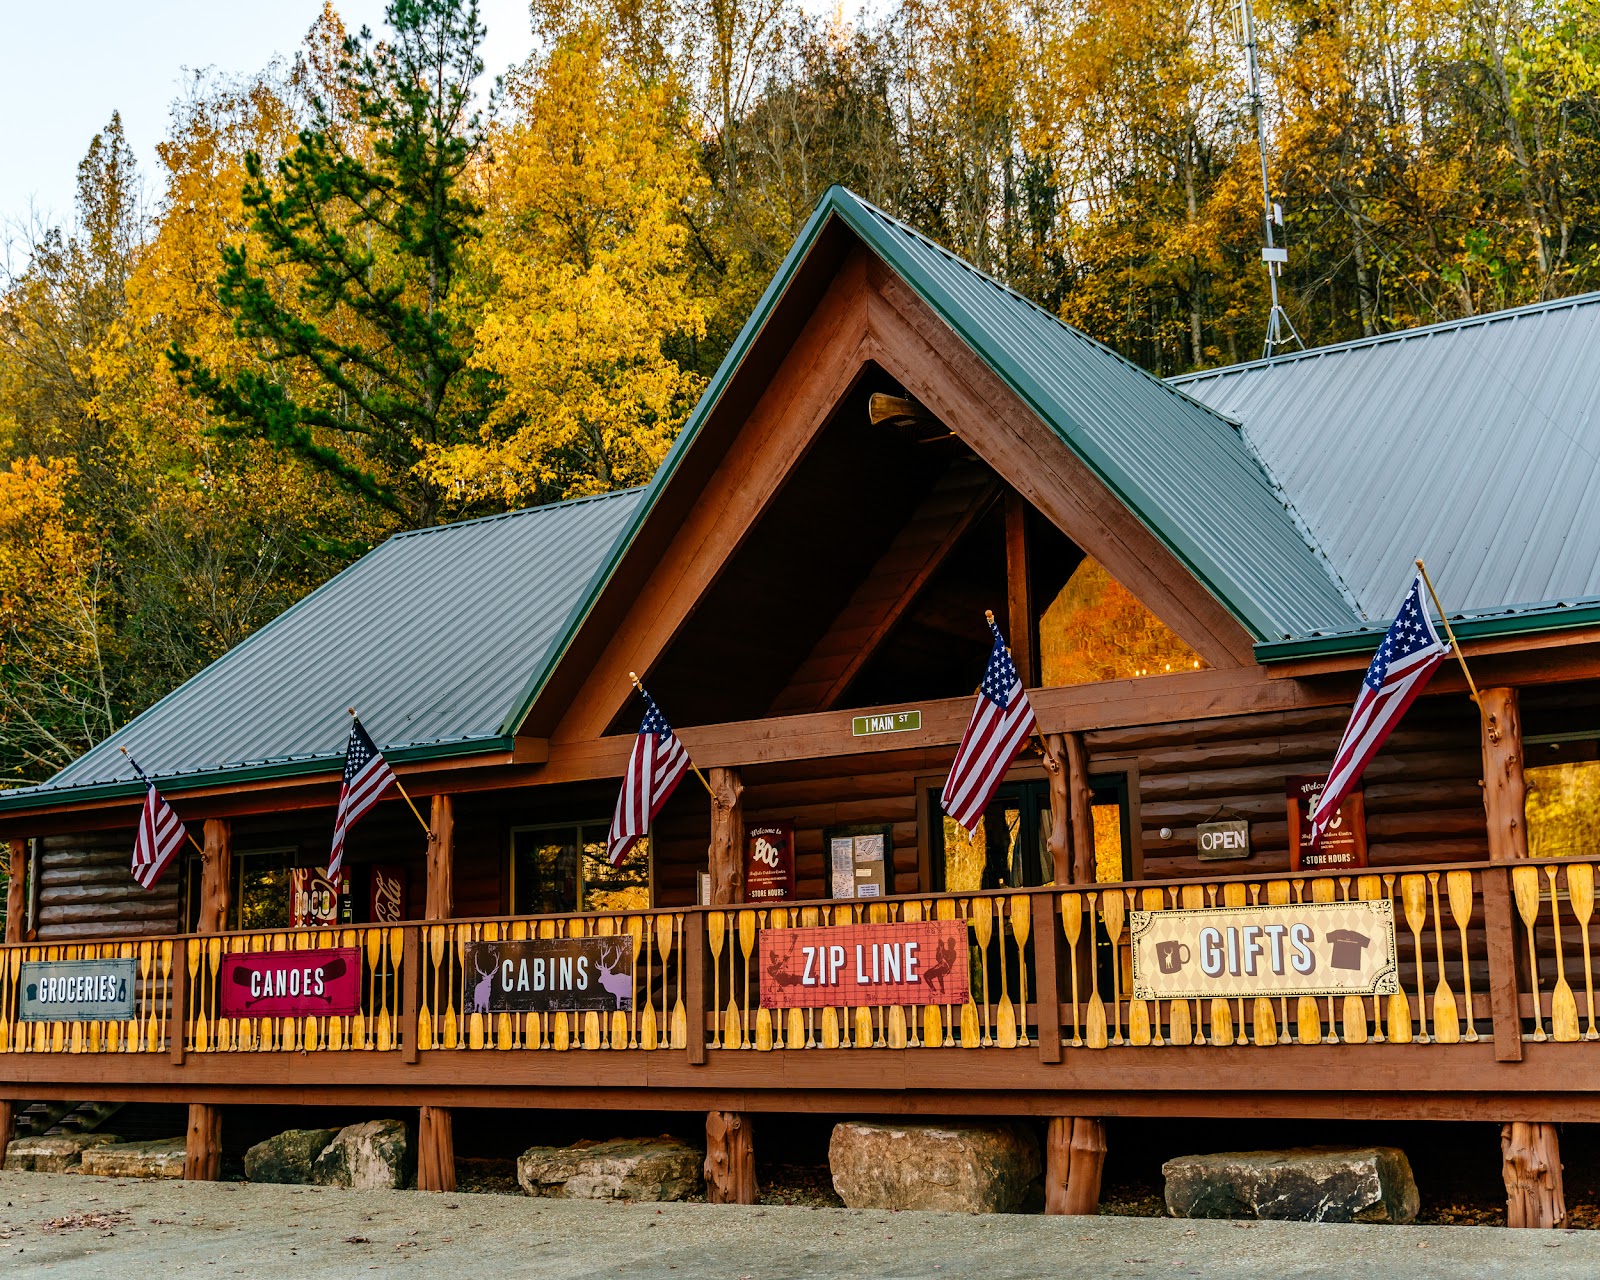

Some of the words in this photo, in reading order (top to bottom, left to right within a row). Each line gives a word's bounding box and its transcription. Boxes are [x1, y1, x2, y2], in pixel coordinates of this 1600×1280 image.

[871, 716, 894, 731] MAIN
[899, 714, 908, 722] ST
[1301, 782, 1326, 793] Welco
[753, 837, 779, 868] BOC
[1201, 830, 1246, 850] OPEN
[1306, 855, 1327, 864] STORE
[1328, 853, 1351, 863] HOURS
[751, 889, 767, 898] STORE
[767, 888, 785, 897] HOURS
[802, 945, 846, 987] ZIP
[856, 942, 920, 984] LINE
[1199, 923, 1316, 978] GIFTS
[251, 967, 324, 998] CANOES
[501, 956, 588, 992] CABINS
[39, 975, 117, 1003] GROCERIES
